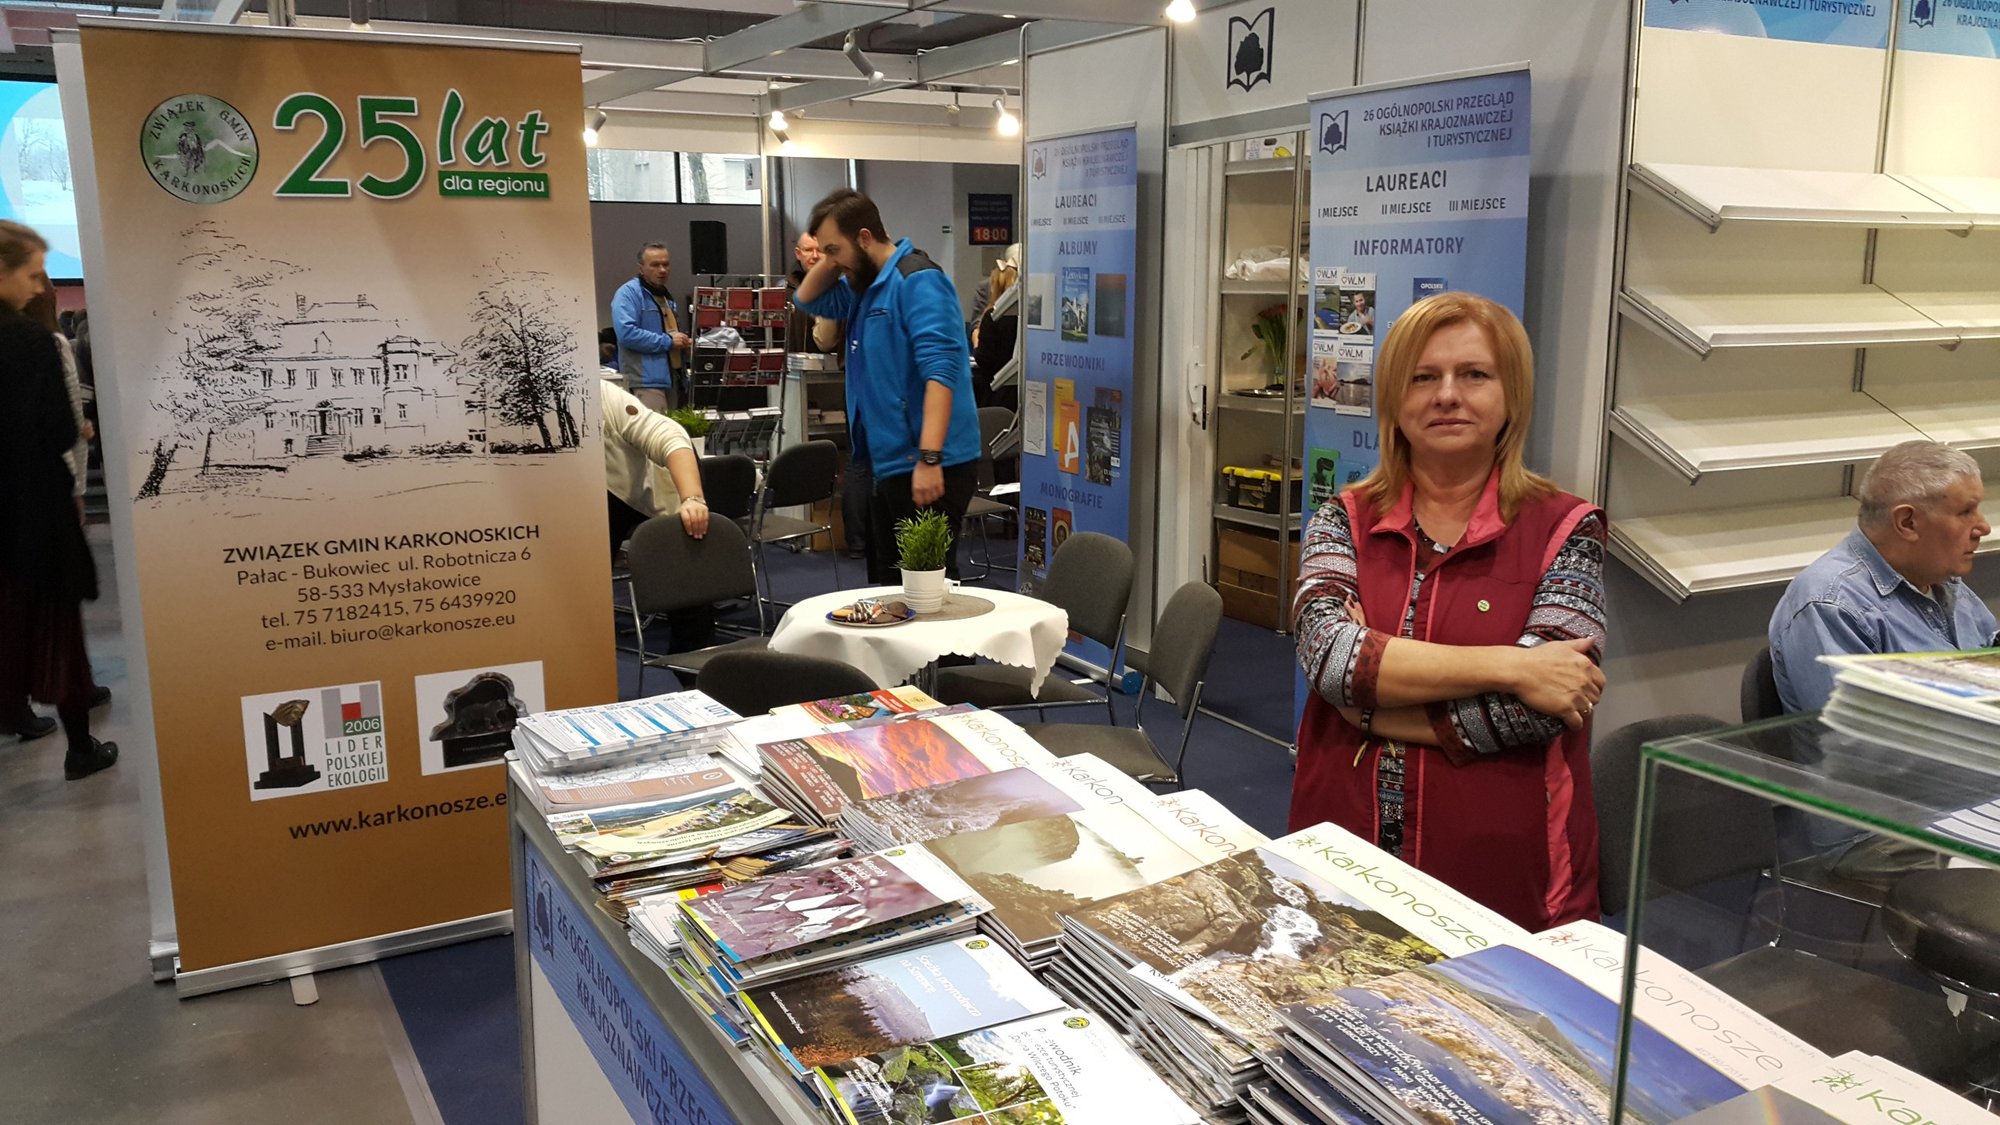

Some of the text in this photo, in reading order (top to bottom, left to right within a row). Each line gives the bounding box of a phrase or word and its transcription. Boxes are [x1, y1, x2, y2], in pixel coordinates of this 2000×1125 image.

[1809, 4, 1876, 17] TURYSTYCZNEJ
[150, 101, 249, 141] ZWIĄZEK GMIN
[1364, 91, 1515, 122] 26 OGÓLNOPOLSKI PRZEGLĄD
[1379, 109, 1513, 137] KSIĄŻKI KRAJOZNAWCZEJ
[1433, 127, 1512, 148] TURYSTYCZNEJ
[273, 88, 550, 199] 25 lat
[153, 158, 251, 195] KARKONOSKICH
[443, 175, 545, 194] dla regionu
[1366, 170, 1447, 193] LAUREACI
[1055, 194, 1098, 209] LAUREACI
[1322, 206, 1358, 217] MIEJSCE
[1389, 202, 1431, 214] MIEJSCE
[1461, 197, 1506, 211] MIEJSCE
[1058, 241, 1098, 256] ALBUMY
[1353, 236, 1464, 256] INFORMATORY
[1041, 351, 1105, 371] PRZEWODNIKI
[1040, 482, 1103, 509] MONOGRAFIE
[223, 524, 540, 564] ZWIĄZEK GMIN KARKONOSKICH
[236, 566, 288, 586] Pałac
[303, 559, 391, 580] Bukowiec
[398, 556, 418, 572] ul.
[423, 547, 517, 569] Robotnicza
[520, 546, 531, 561] 6
[297, 573, 481, 603] 58-533 Mysłakowice
[261, 612, 290, 630] tel.
[294, 609, 318, 626] 75
[413, 598, 436, 614] 75
[439, 589, 516, 611] 6439920
[265, 613, 516, 651] e-mail. biuro@karkonosze.eu
[345, 717, 380, 734] 2006
[325, 735, 383, 756] LIDER
[960, 717, 1030, 768] Karkonosz
[326, 751, 384, 772] POLSKIEJ
[328, 767, 386, 787] EKOLOGII
[1063, 766, 1126, 805] Karkon
[289, 791, 508, 840] www.karkonosze.e
[1168, 807, 1241, 863] Karkon
[1314, 846, 1488, 949] Karkonosze
[556, 907, 712, 1125] 26 OGÓLNOPOLSKI PRZEG
[576, 972, 677, 1125] KRAJOZNAWCZE
[1336, 1024, 1382, 1056] KARKONOSZY
[1421, 1069, 1442, 1084] RADY
[1440, 1085, 1480, 1117] NAUKOWEJ
[1856, 1089, 1938, 1125] Ka
